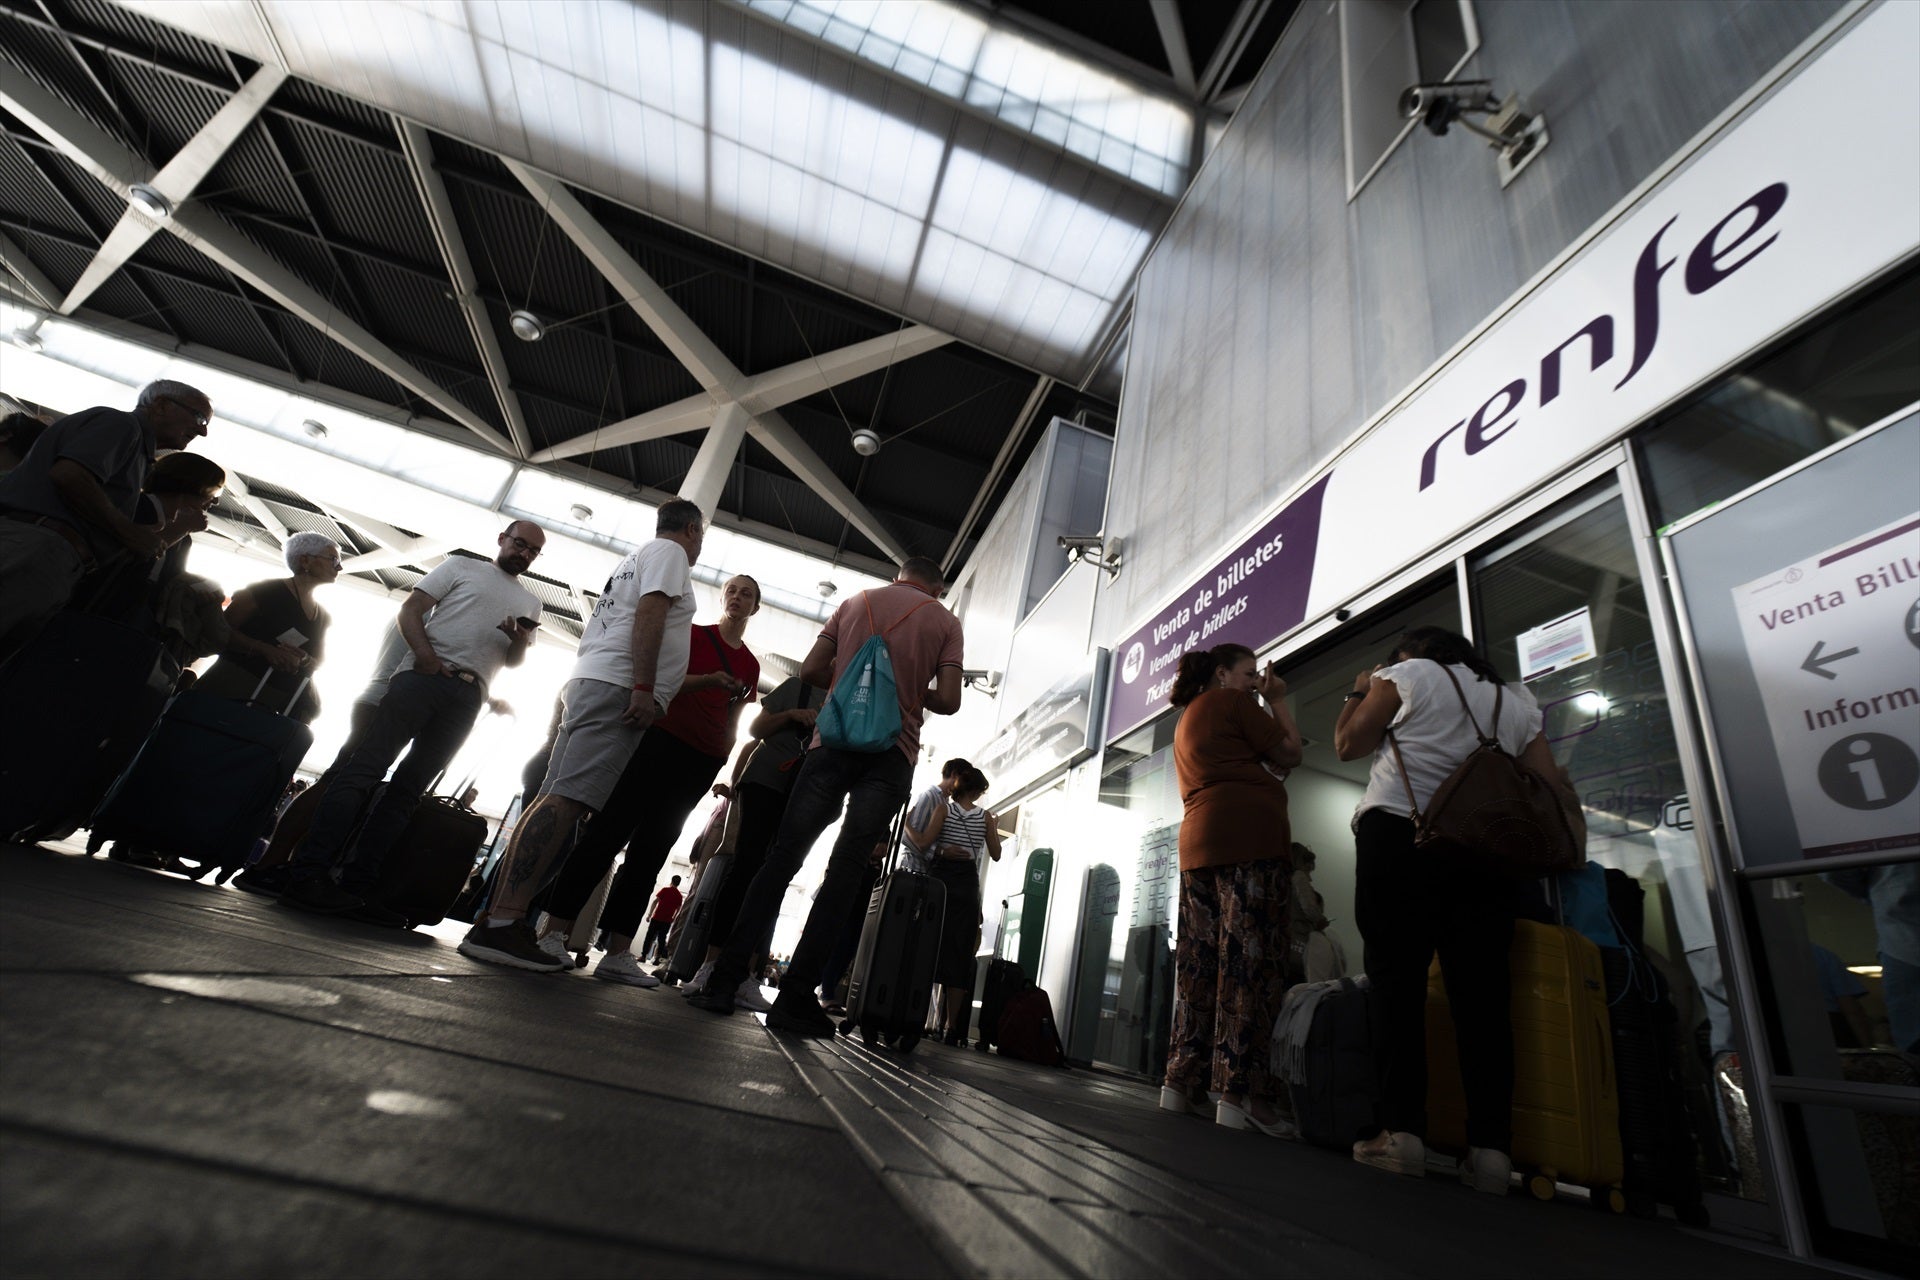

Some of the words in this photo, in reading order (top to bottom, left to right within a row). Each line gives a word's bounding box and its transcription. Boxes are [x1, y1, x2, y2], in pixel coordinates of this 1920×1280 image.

[1419, 181, 1790, 493] renfe
[1153, 607, 1190, 646] Venta
[1194, 590, 1213, 616] de
[1217, 533, 1284, 598] billetes
[1759, 591, 1846, 631] Venta
[1855, 556, 1920, 597] Bill
[1149, 643, 1182, 676] Venda
[1184, 630, 1200, 652] de
[1201, 595, 1249, 640] bitllets
[1145, 673, 1179, 706] Ticket
[1144, 855, 1168, 871] renfe
